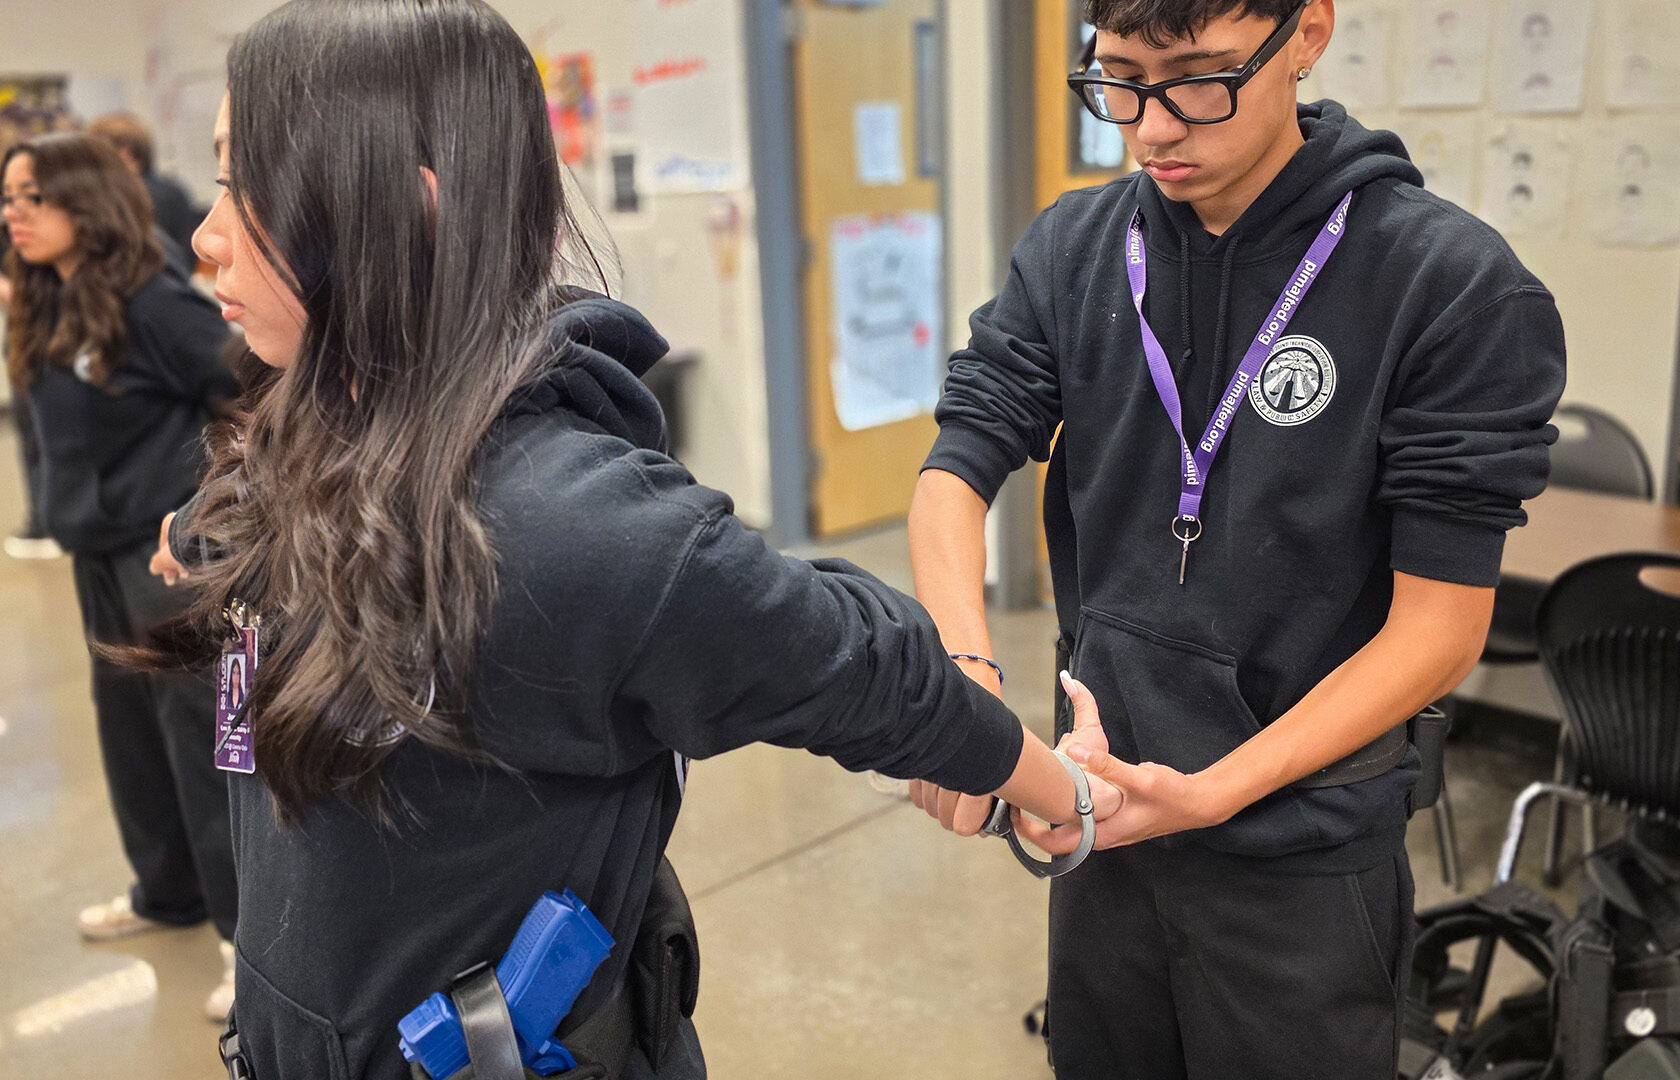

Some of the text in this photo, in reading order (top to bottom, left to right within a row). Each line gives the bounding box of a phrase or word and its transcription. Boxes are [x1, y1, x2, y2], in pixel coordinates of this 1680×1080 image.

[1257, 259, 1317, 346] pimajted.org
[1200, 370, 1250, 453] pimajted.org
[1252, 385, 1263, 403] LAW
[1295, 398, 1324, 420] SAFETY
